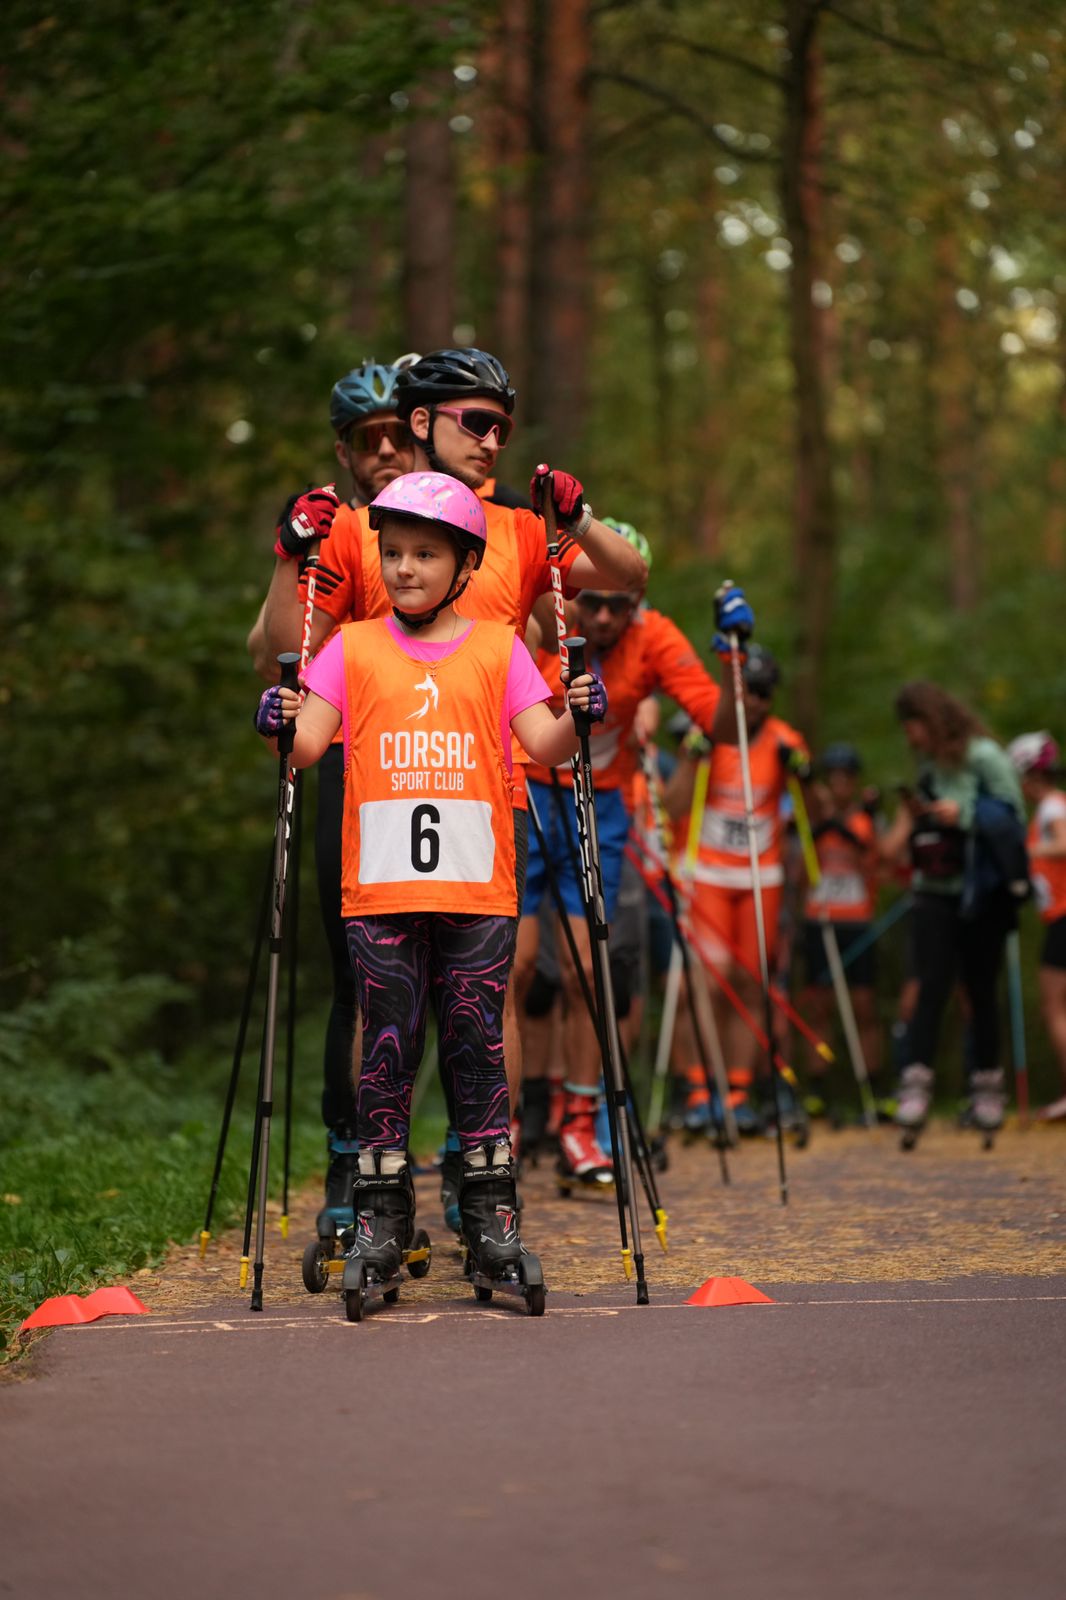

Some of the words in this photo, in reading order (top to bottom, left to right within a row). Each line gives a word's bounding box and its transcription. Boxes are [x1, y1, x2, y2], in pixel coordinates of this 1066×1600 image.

[379, 731, 477, 770] CORSAC
[391, 772, 431, 791] SPORT
[434, 772, 464, 791] CLUB
[410, 803, 441, 873] 6
